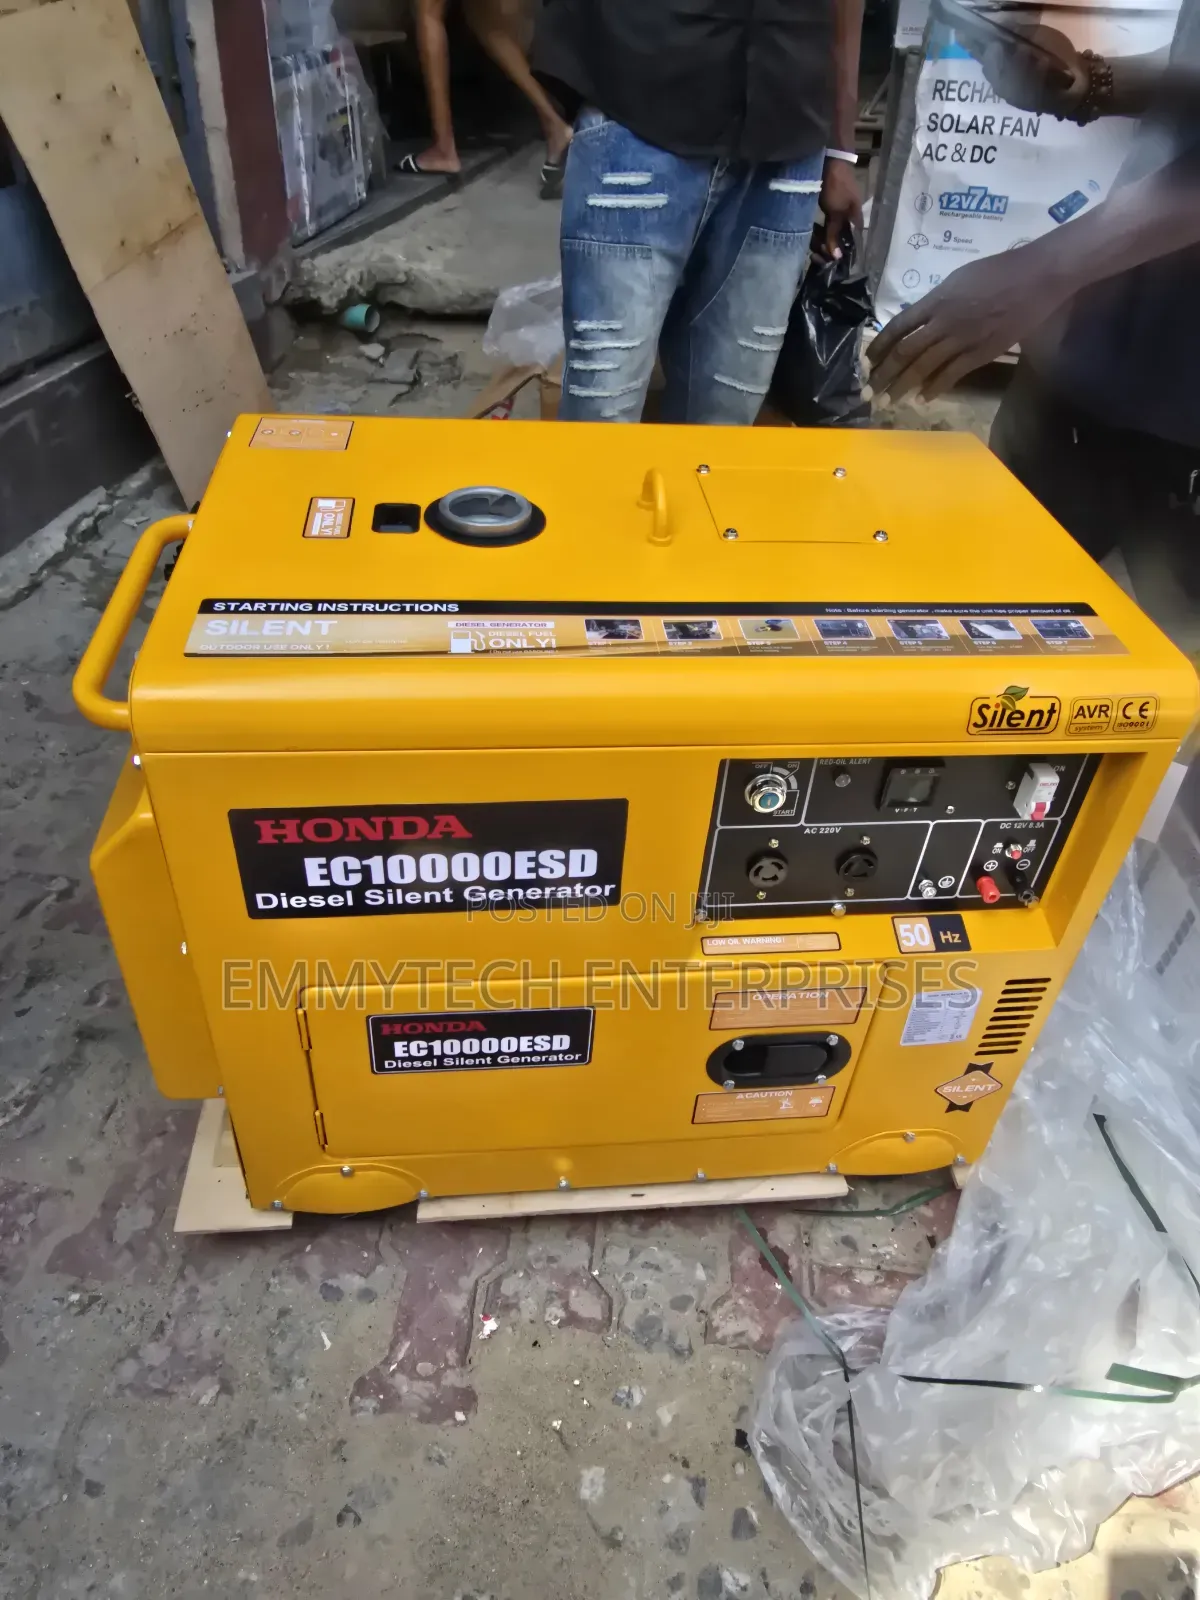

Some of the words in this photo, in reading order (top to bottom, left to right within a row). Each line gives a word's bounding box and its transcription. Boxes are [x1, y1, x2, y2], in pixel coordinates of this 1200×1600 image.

[932, 79, 1001, 104] RECHA
[926, 112, 996, 136] SOLAR
[999, 116, 1041, 138] FAN
[920, 143, 948, 162] AC
[951, 143, 967, 163] &
[969, 145, 998, 164] DC
[943, 230, 952, 243] 9
[953, 236, 973, 244] Speed
[212, 602, 314, 612] STARTING
[317, 602, 461, 613] INSTRUCTIONS
[203, 619, 338, 637] SILENT
[488, 638, 557, 649] ONLY!
[972, 702, 1057, 729] Silent
[1073, 704, 1110, 720] AVR
[1121, 701, 1150, 720] CE
[1074, 724, 1104, 733] system
[819, 758, 847, 766] RED-OIL
[849, 757, 872, 765] ALERT
[253, 814, 473, 845] HONDA
[803, 827, 818, 835] AC
[819, 826, 842, 834] 220V
[999, 822, 1012, 830] DC
[1013, 821, 1028, 829] 12V
[1028, 821, 1045, 829] 8.3A
[303, 848, 599, 888] EC10000ESD
[254, 889, 354, 910] Diesel
[364, 886, 454, 907] Silent
[463, 882, 617, 903] Generator
[707, 938, 726, 947] LOW
[898, 923, 931, 947] 50
[939, 930, 962, 944] Hz
[752, 991, 830, 1001] OPERATION
[379, 1020, 487, 1036] HONDA
[393, 1034, 572, 1058] EC10000ESD
[384, 1058, 438, 1069] Diesel
[442, 1056, 493, 1067] Silent
[497, 1052, 583, 1064] Generator
[745, 1090, 793, 1099] CAUTION
[942, 1083, 996, 1093] SILENT
